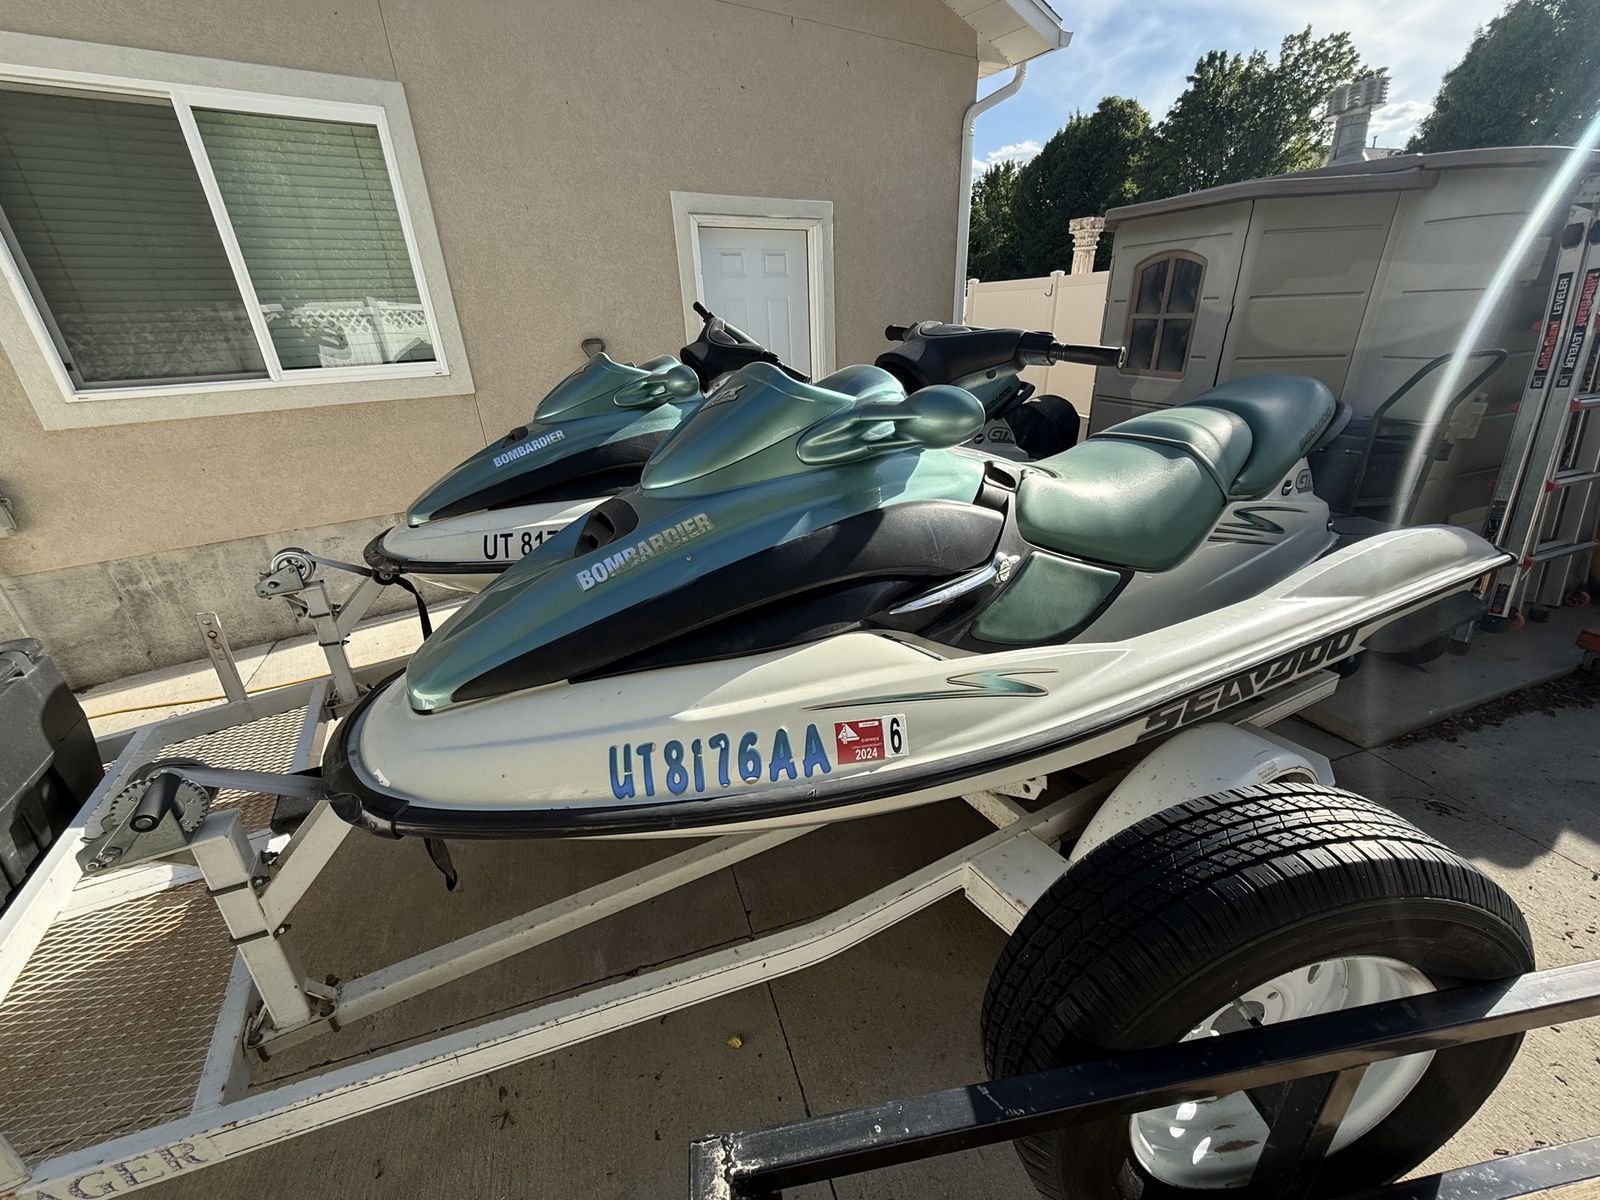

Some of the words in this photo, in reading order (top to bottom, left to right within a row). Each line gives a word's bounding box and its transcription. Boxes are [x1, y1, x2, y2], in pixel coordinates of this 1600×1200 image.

[1552, 277, 1570, 316] LEVELER
[492, 429, 566, 469] BOMBARDIER
[483, 533, 513, 560] UT
[521, 529, 559, 552] 81
[575, 512, 715, 593] BOMBARDIER
[855, 747, 878, 760] 2024
[890, 717, 902, 754] 6
